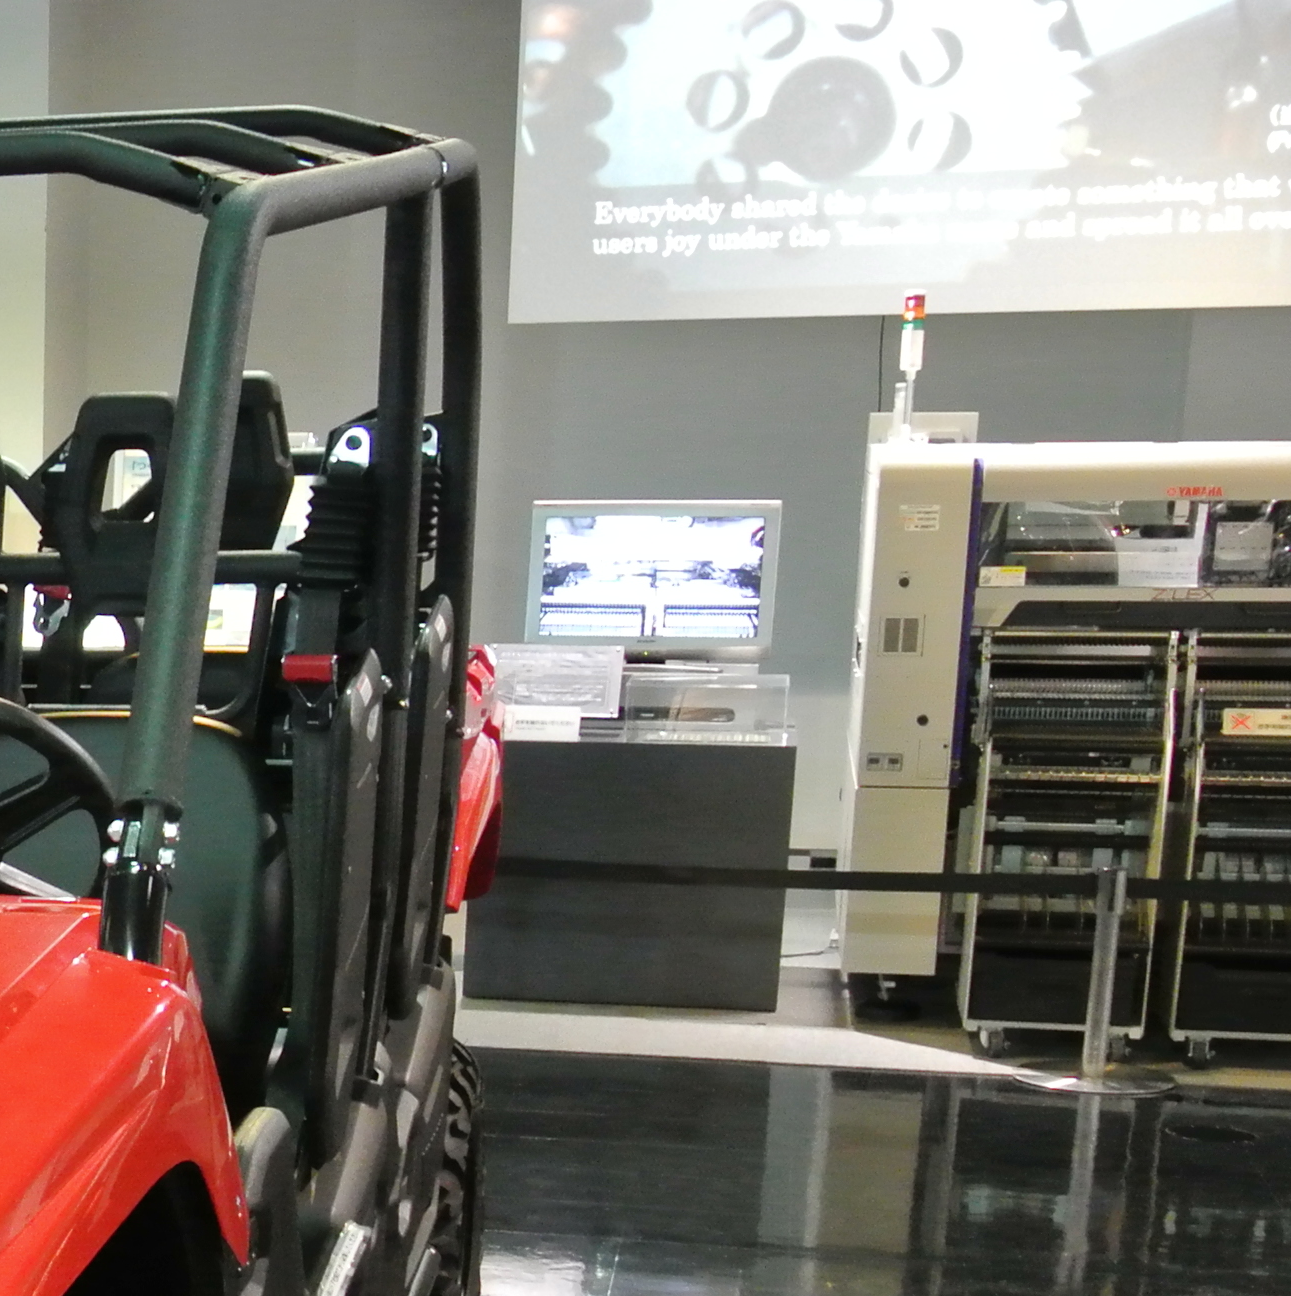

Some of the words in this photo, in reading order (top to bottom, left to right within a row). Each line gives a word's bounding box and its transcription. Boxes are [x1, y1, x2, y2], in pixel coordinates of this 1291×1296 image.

[594, 196, 725, 227] Everybody
[731, 190, 817, 219] shared
[592, 235, 658, 254] users
[662, 229, 702, 258] joy
[708, 225, 783, 251] under
[789, 222, 830, 248] the
[1025, 211, 1076, 238] and
[1179, 208, 1200, 232] it
[1207, 205, 1243, 232] all
